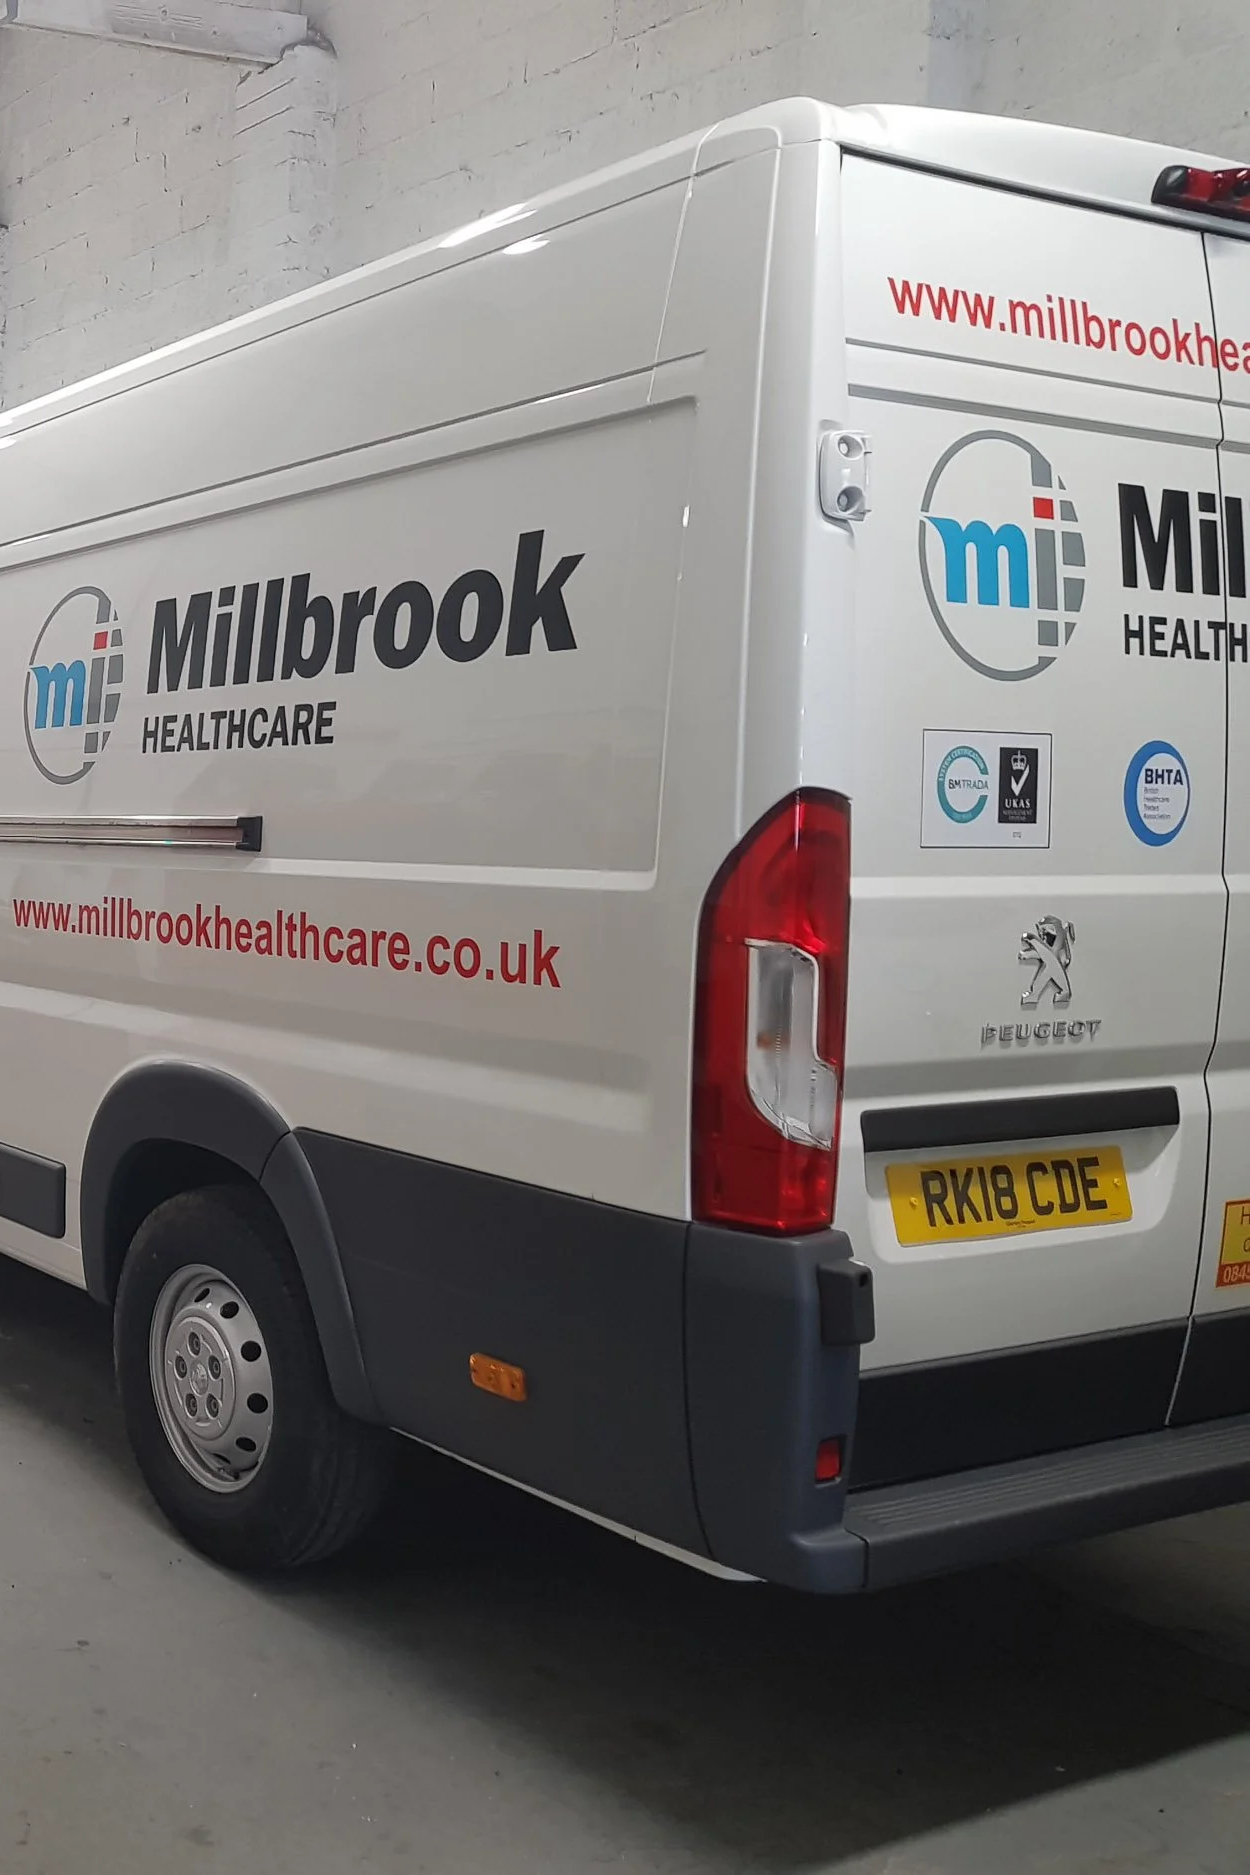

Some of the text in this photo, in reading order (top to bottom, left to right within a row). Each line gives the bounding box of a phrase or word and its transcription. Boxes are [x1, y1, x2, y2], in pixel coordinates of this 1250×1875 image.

[147, 529, 585, 695] Millbrook
[1123, 613, 1249, 664] HEALTH
[142, 701, 337, 754] HEALTHCARE
[1144, 768, 1184, 785] BHTA
[1004, 798, 1031, 809] UKAS
[13, 896, 561, 988] www.millbrookhealthcare.co.uk
[981, 1019, 1102, 1044] PEUGEOT
[920, 1156, 1108, 1227] RK18 CDE
